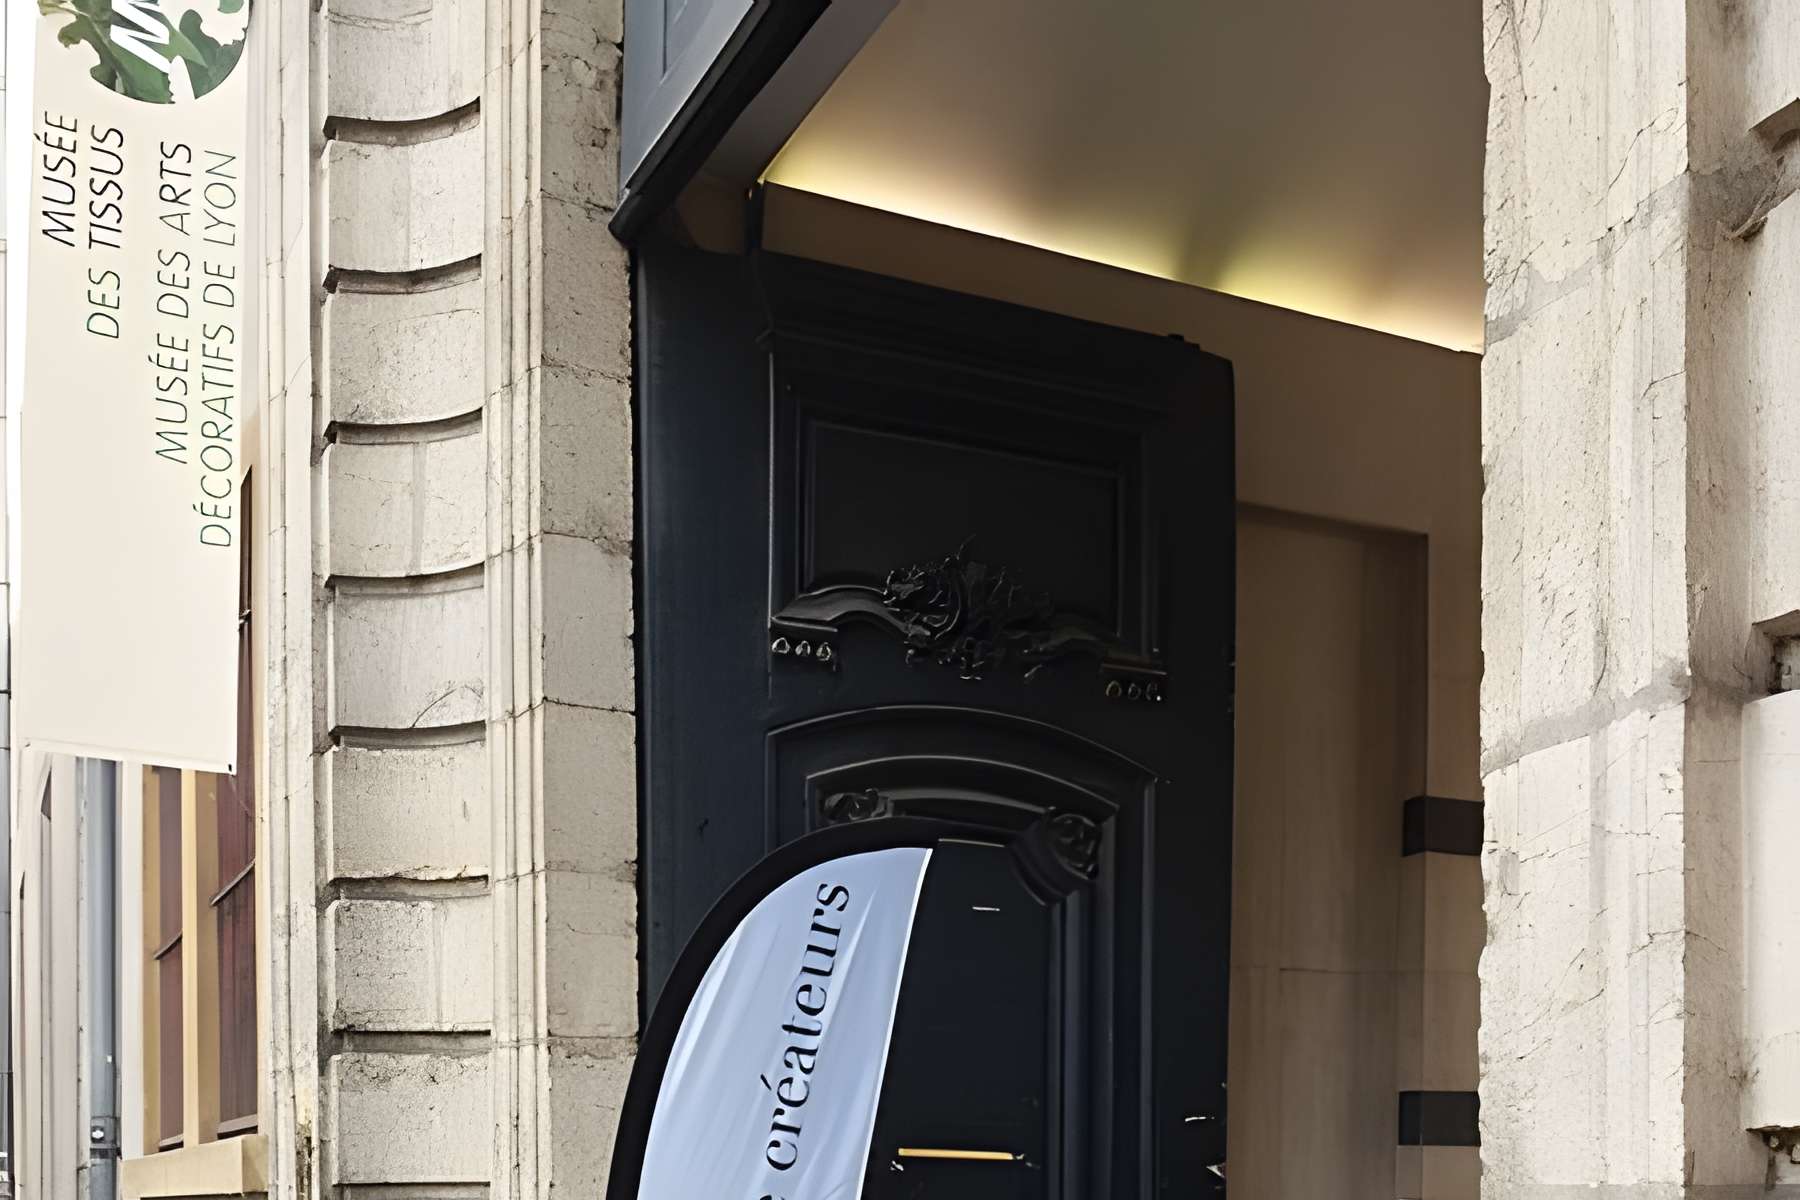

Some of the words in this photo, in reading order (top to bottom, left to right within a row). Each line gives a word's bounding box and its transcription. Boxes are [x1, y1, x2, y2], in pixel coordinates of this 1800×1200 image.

[34, 111, 77, 247] MUSÉE
[89, 124, 124, 250] TISSUS
[159, 140, 192, 236] ARTS
[203, 149, 237, 247] LYON
[86, 268, 120, 339] DES
[157, 249, 190, 319] DES
[203, 260, 236, 308] DE
[148, 332, 190, 465] MUSÉE
[193, 323, 234, 548] DÉCORATIFS
[760, 882, 850, 1172] créateurs
